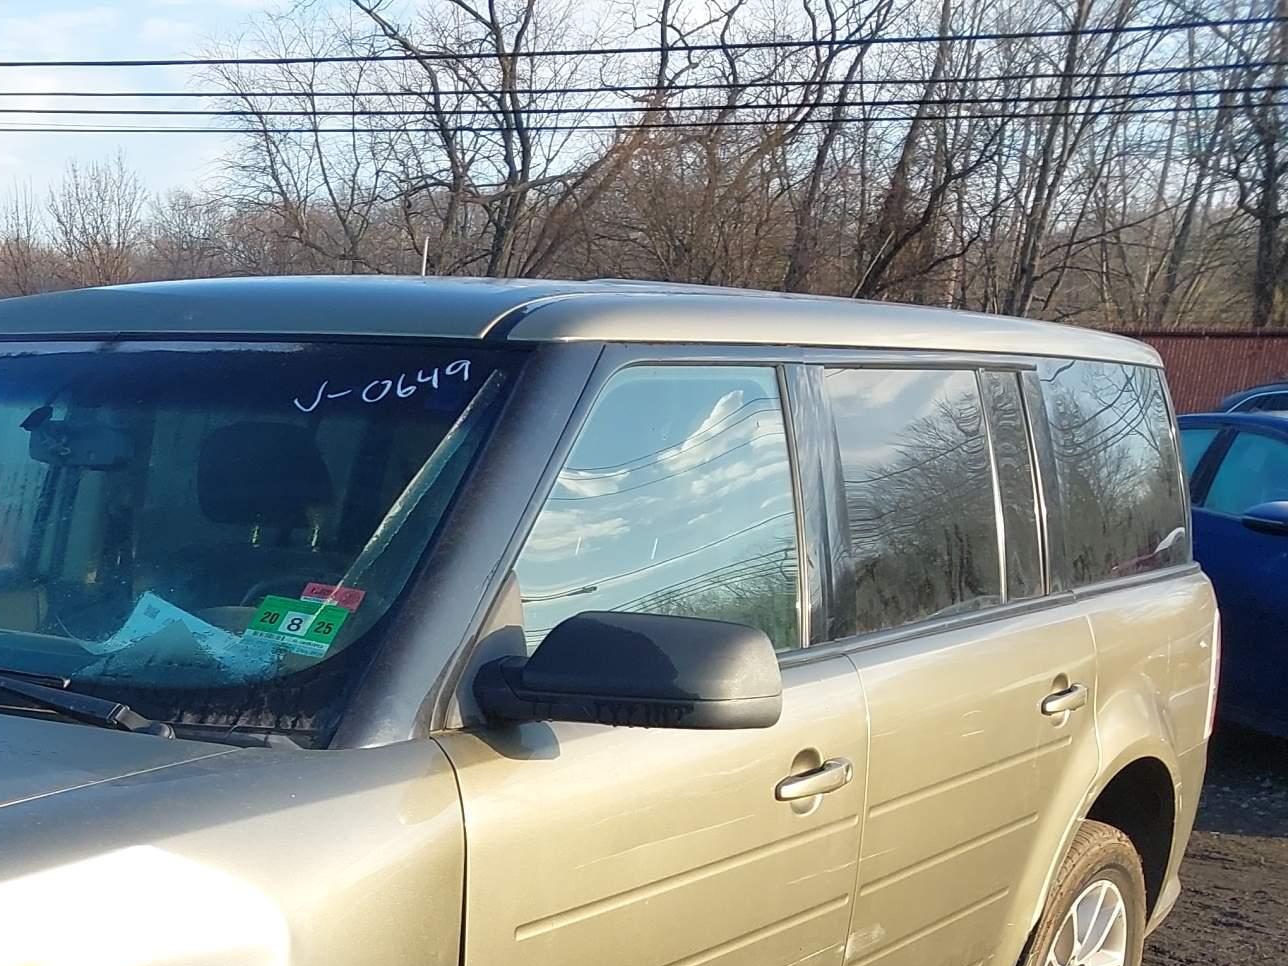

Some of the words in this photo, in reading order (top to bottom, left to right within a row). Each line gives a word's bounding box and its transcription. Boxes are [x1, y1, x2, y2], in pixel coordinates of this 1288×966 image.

[259, 611, 281, 625] 20
[286, 617, 304, 632] 8
[313, 620, 335, 636] 25
